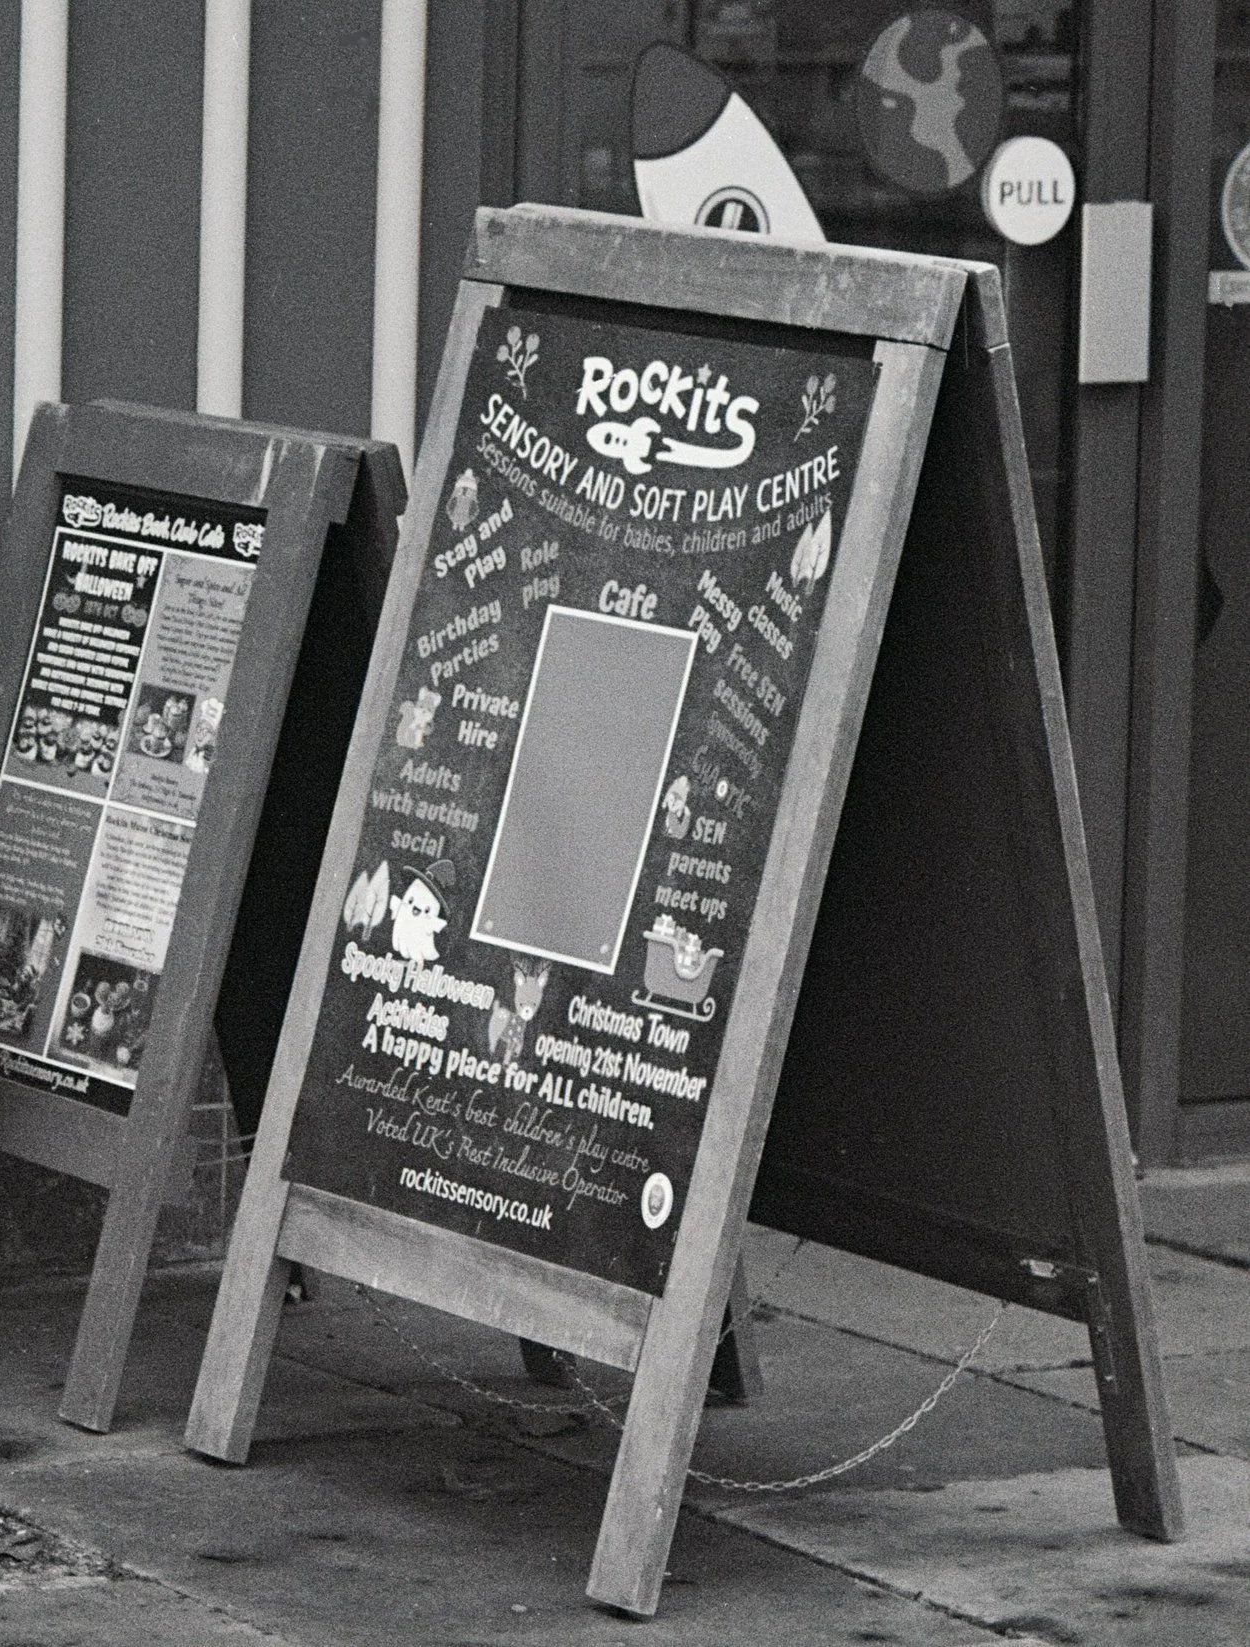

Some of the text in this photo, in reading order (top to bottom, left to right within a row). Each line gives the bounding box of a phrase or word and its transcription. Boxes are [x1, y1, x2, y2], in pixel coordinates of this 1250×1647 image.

[999, 179, 1066, 205] PULL
[480, 393, 841, 523] SENSORY AND SOFT PLAY CENTRE
[476, 432, 833, 557] Sessions suitable for babies, children and adults
[434, 498, 514, 578] Stay and
[520, 540, 559, 572] Role
[464, 545, 506, 588] Play
[599, 580, 658, 620] Cafe
[697, 569, 743, 632] Messy
[765, 571, 802, 622] Music
[417, 599, 502, 659] Birthday
[688, 605, 722, 654] Play
[748, 605, 793, 660] classes
[451, 683, 520, 719] Private
[726, 642, 788, 717] Free SEN
[457, 719, 499, 750] Hire
[713, 679, 770, 746] sessions
[400, 758, 462, 792] Adults
[372, 788, 480, 833] with autism
[692, 815, 728, 844] SEN
[391, 829, 445, 859] social
[666, 851, 732, 884] parents
[654, 885, 728, 923] meet ups
[341, 941, 496, 1010] Spooky Halloween
[366, 992, 449, 1042] Activities
[568, 995, 690, 1054] Christmas Town
[361, 1023, 654, 1130] A happy place for ALL children.
[535, 1034, 707, 1101] opening 21st November
[335, 1063, 650, 1173] Awarded Kent's best children's play centre
[366, 1107, 420, 1142] Voted
[412, 1121, 454, 1159] UK's
[492, 1145, 559, 1186] Inclusive
[562, 1167, 629, 1210] Operator
[400, 1168, 553, 1229] rockitssensory.co.uk
